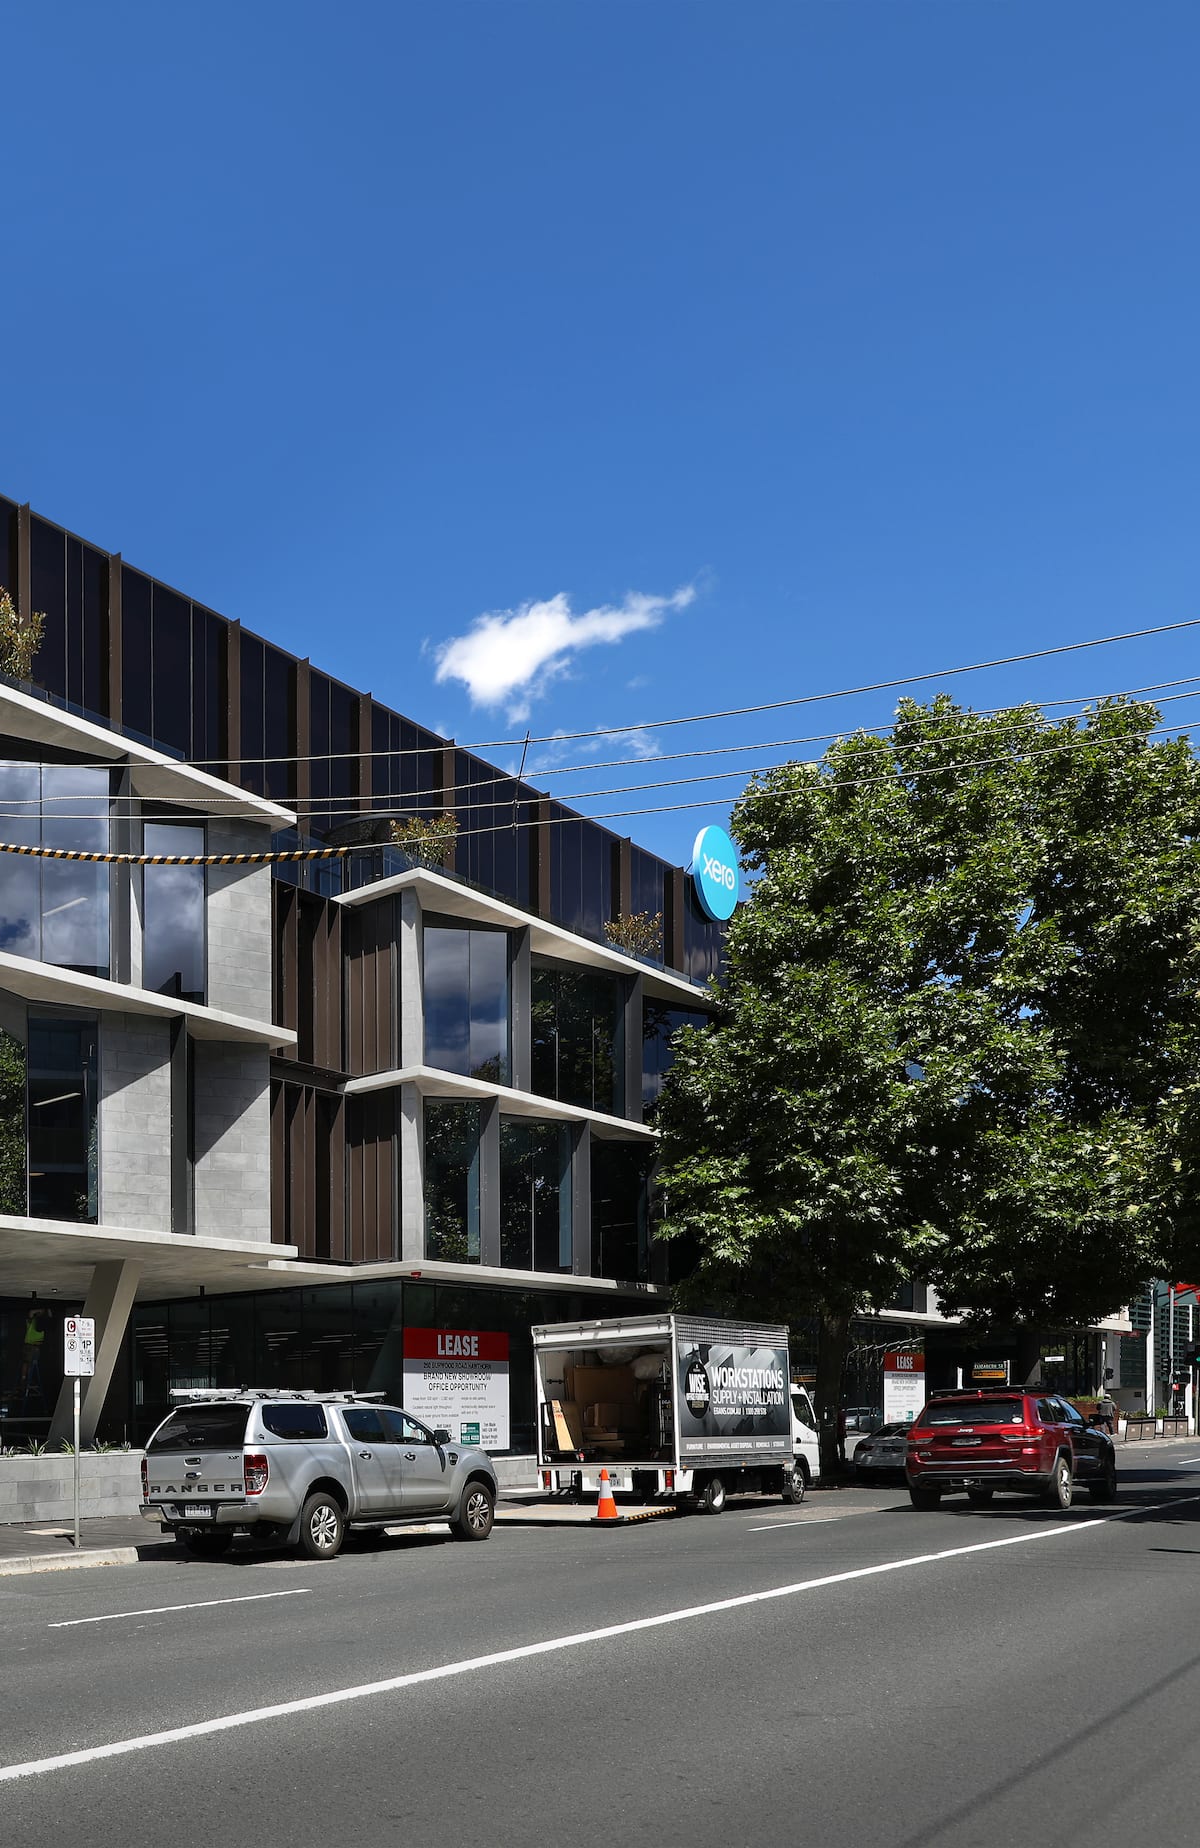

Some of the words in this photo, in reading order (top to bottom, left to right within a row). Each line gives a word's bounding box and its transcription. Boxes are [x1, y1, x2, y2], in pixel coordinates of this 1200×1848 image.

[703, 853, 735, 890] xero
[81, 1339, 92, 1349] 1P
[437, 1334, 479, 1356] LEASE
[896, 1355, 913, 1369] LEASE
[689, 1373, 706, 1393] WISE
[710, 1366, 784, 1389] WORKSTATIONS
[428, 1383, 449, 1391] OFFICE
[449, 1383, 488, 1391] OPPORTUNITY
[150, 1484, 243, 1493] RANGER
